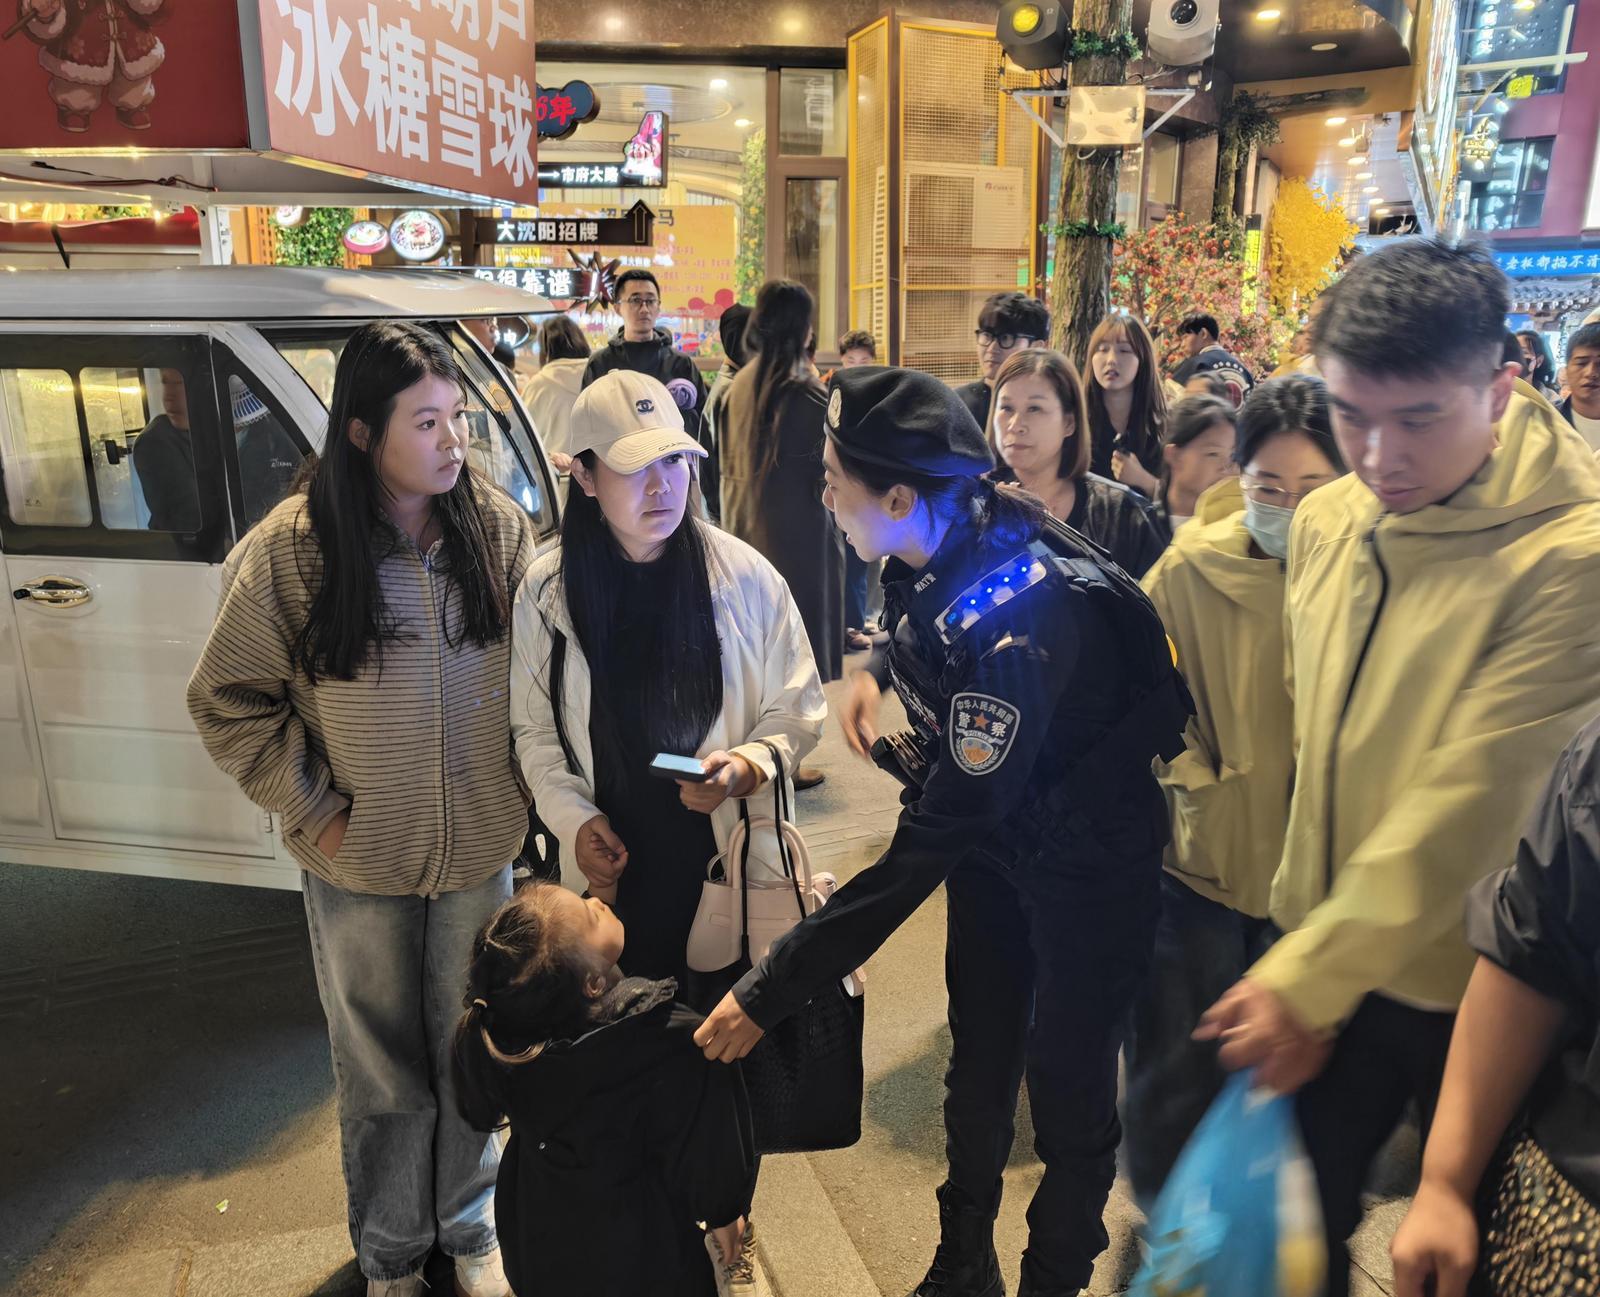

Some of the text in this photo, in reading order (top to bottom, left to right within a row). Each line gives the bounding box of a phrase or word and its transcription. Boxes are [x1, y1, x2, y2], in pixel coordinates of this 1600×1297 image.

[274, 0, 535, 188] 冰糖雪球
[561, 167, 619, 183] 市府大路
[497, 221, 598, 242] 大沈阳招牌
[956, 700, 1015, 725] 中华人民共和国
[958, 711, 1006, 737] 警 察
